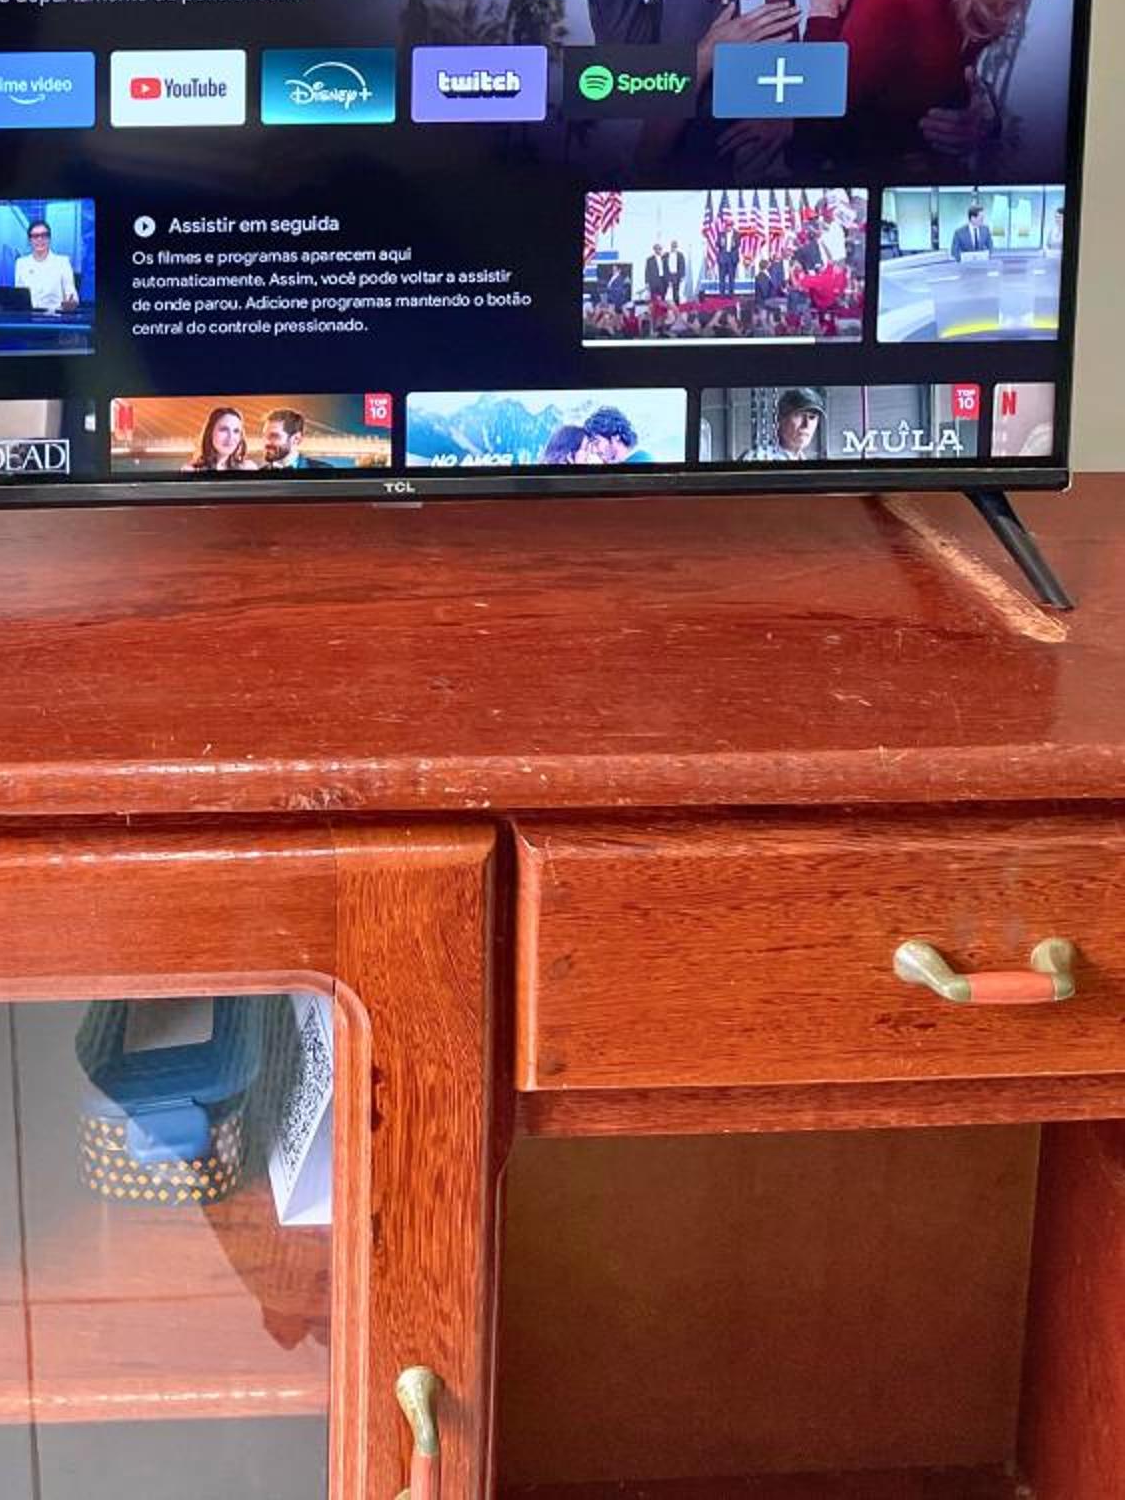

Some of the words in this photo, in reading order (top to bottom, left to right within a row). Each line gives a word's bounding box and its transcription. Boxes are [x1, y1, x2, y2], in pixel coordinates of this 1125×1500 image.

[30, 75, 73, 92] video
[164, 77, 228, 98] YouTube
[437, 70, 521, 97] twitch
[617, 73, 686, 93] Spotify
[168, 217, 235, 233] Assistir
[239, 219, 267, 233] em
[270, 215, 340, 236] seguida
[132, 251, 154, 265] Os
[157, 250, 202, 265] filmes
[204, 252, 214, 264] e
[217, 250, 298, 267] programas
[300, 250, 375, 266] aparecem
[378, 247, 412, 264] aqui
[132, 274, 266, 289] automaticamente.
[268, 272, 318, 287] Assim,
[320, 271, 356, 285] você
[358, 271, 398, 288] pode
[400, 270, 443, 284] voltar
[445, 272, 456, 284] a
[458, 269, 512, 284] assistir
[132, 298, 152, 312] de
[154, 297, 192, 311] onde
[194, 299, 242, 314] parou.
[245, 296, 309, 310] Adicione
[311, 295, 392, 313] programas
[395, 293, 470, 308] mantendo
[473, 295, 484, 307] o
[486, 291, 532, 307] botão
[132, 321, 183, 336] central
[185, 320, 207, 334] do
[209, 319, 272, 334] controle
[274, 318, 369, 337] pressionado.
[956, 388, 976, 398] TOP
[370, 406, 388, 420] 10
[957, 397, 975, 410] 10
[383, 481, 415, 493] TCL
